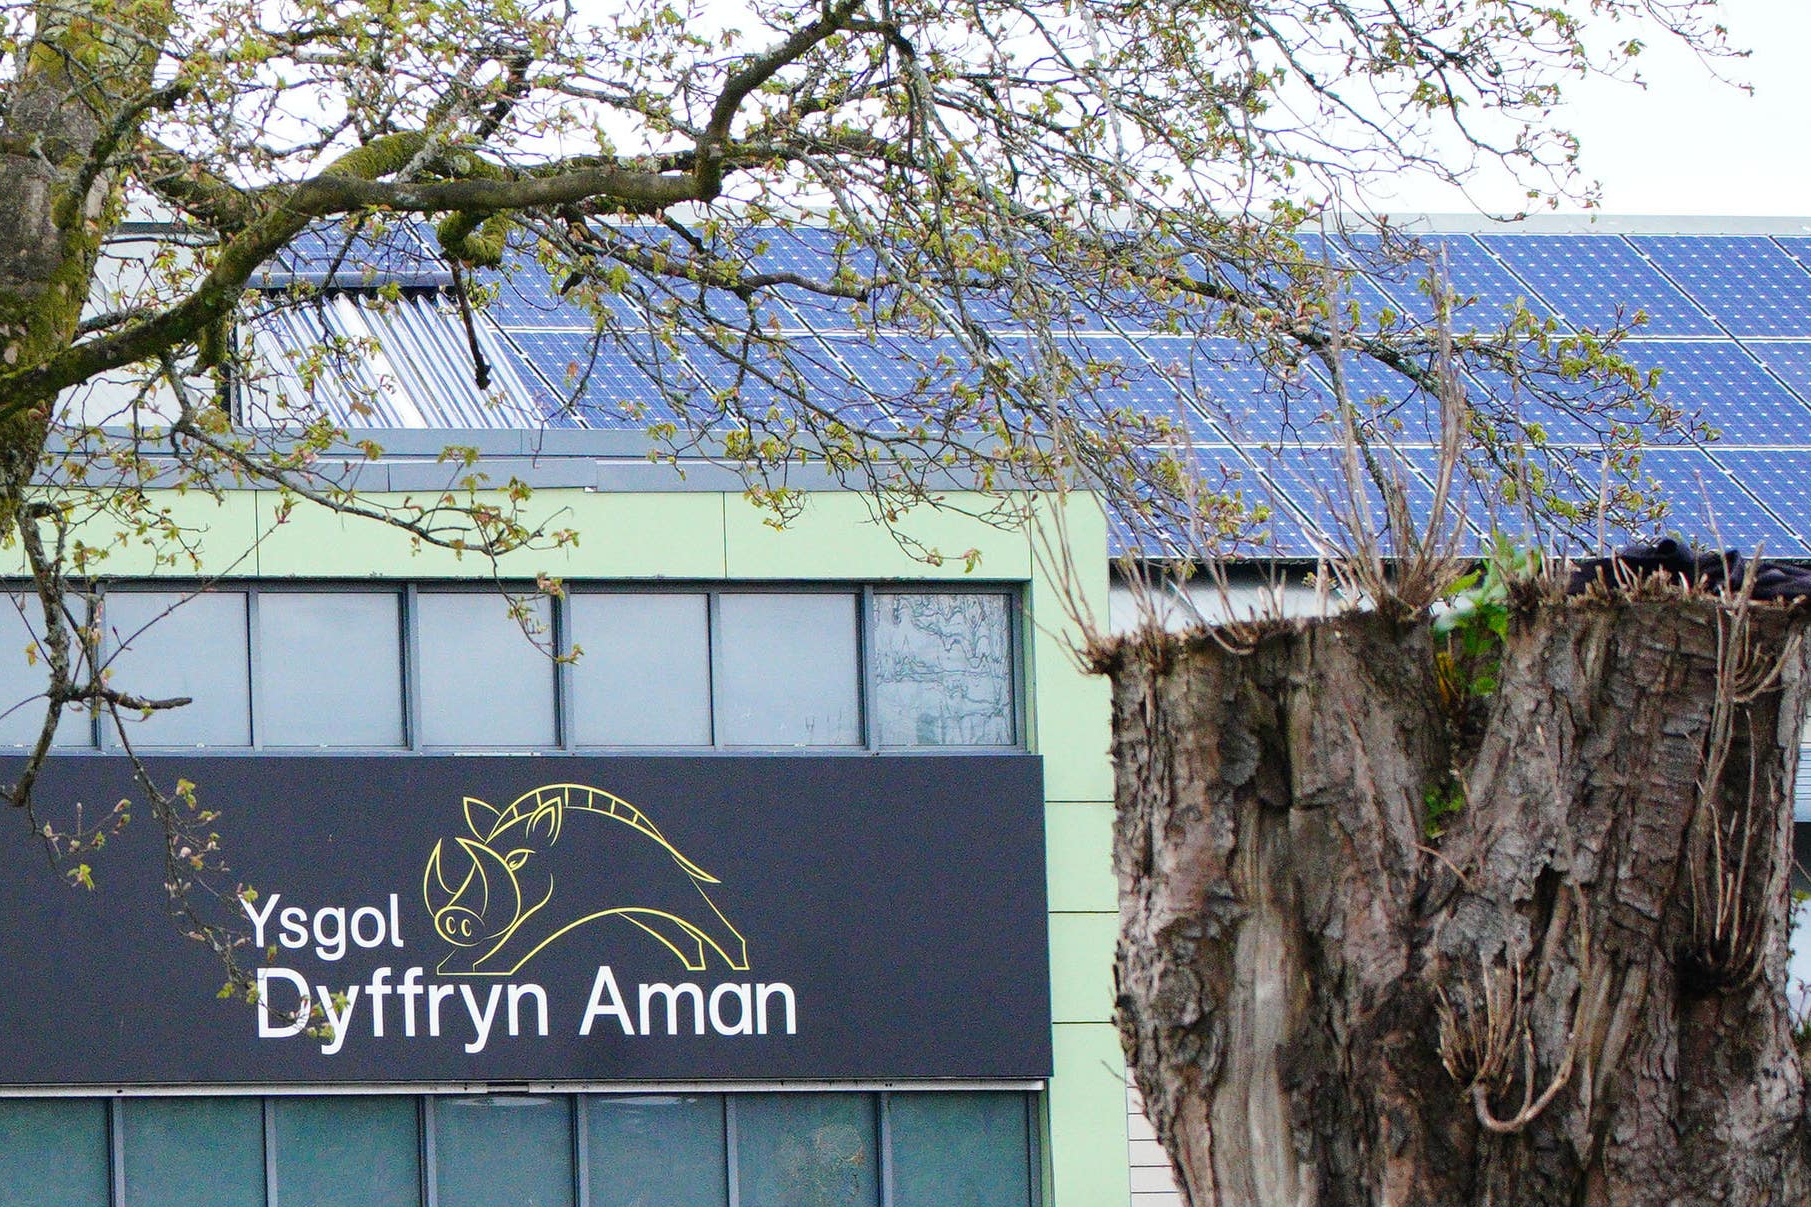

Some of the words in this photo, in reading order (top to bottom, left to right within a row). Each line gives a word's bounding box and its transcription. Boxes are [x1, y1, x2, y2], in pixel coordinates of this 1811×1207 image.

[238, 893, 404, 961] Ysgol
[257, 966, 548, 1054] Dyffryn
[578, 965, 797, 1036] Aman
